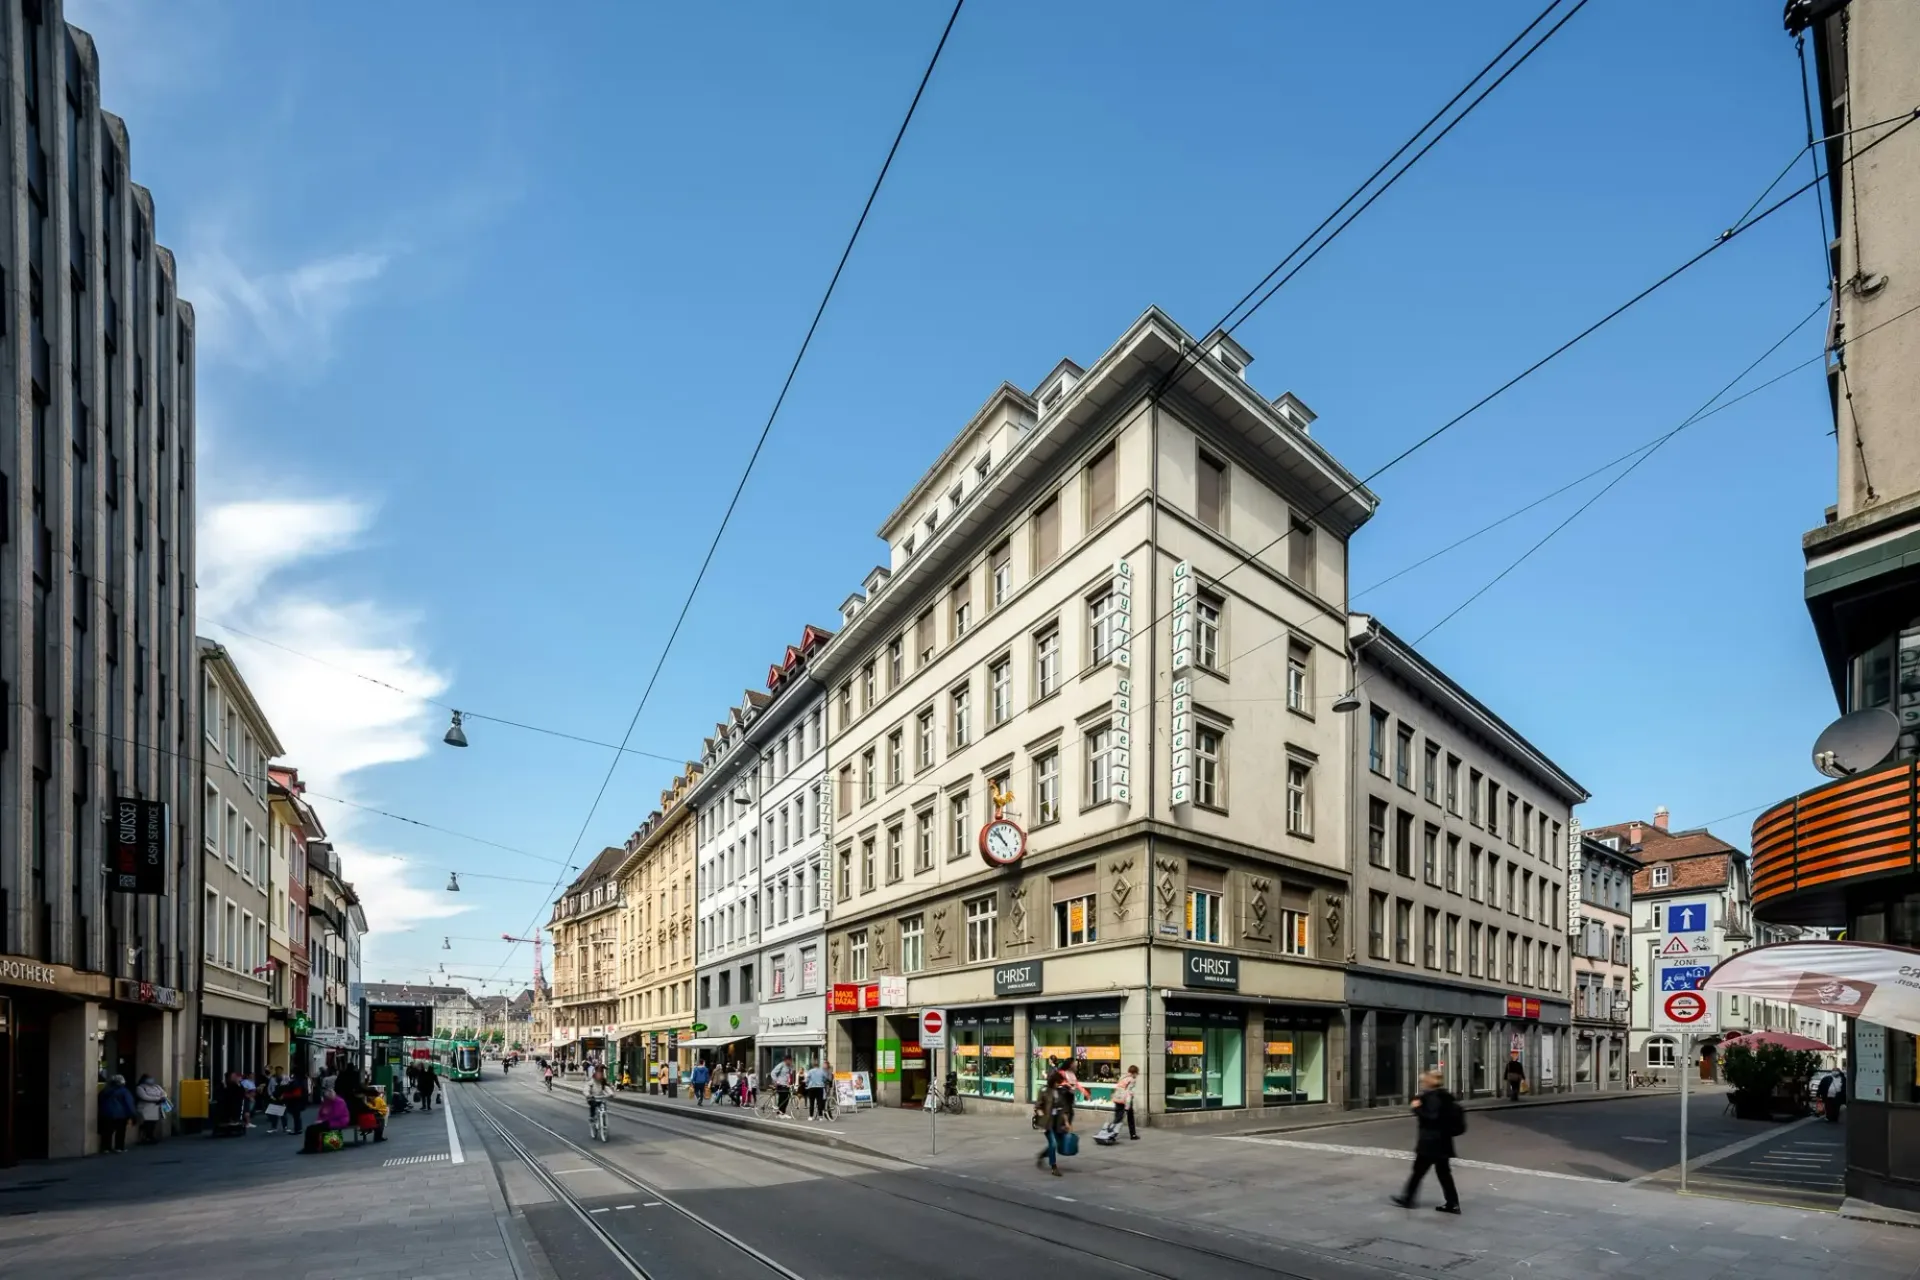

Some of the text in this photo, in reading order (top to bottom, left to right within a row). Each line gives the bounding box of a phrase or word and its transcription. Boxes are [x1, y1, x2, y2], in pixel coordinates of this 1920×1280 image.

[1118, 560, 1130, 799] Gryffe Galerie
[1173, 562, 1186, 801] Gryffe Galerie
[119, 801, 137, 845] (SUISSE)
[147, 806, 160, 865] CASH SERVICE
[1190, 956, 1232, 976] CHRIST
[1673, 958, 1699, 967] ZONE
[996, 966, 1031, 985] CHRIST
[834, 990, 854, 998] MAXI
[834, 997, 857, 1005] BAZAR
